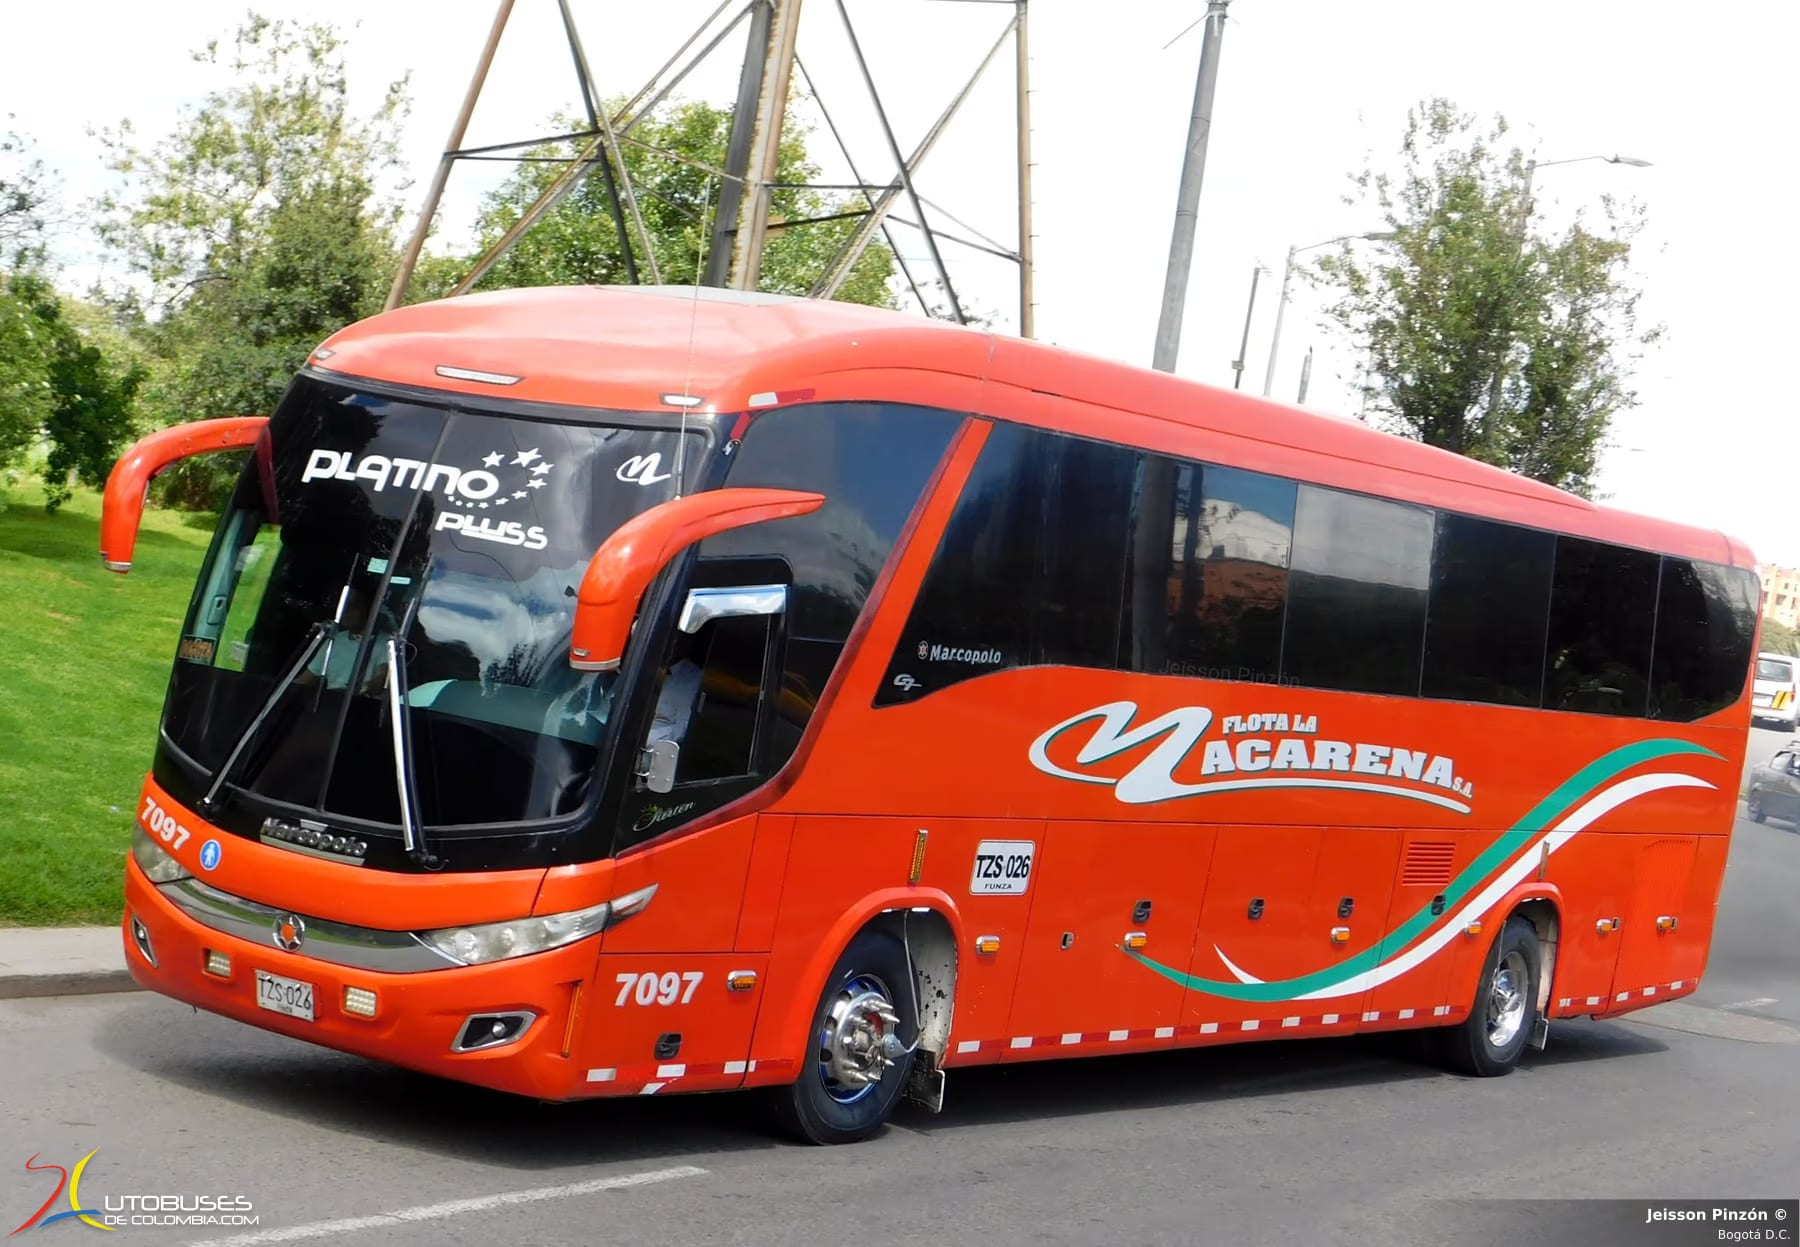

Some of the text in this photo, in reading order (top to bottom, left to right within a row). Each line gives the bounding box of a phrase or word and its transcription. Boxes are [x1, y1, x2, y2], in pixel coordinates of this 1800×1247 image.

[301, 449, 499, 500] PLATINO
[930, 644, 1002, 664] Marcopolo
[1222, 714, 1318, 735] FLOTA LA
[142, 796, 191, 851] 7097
[976, 854, 1031, 879] TZS 026
[615, 971, 704, 1007] 7097
